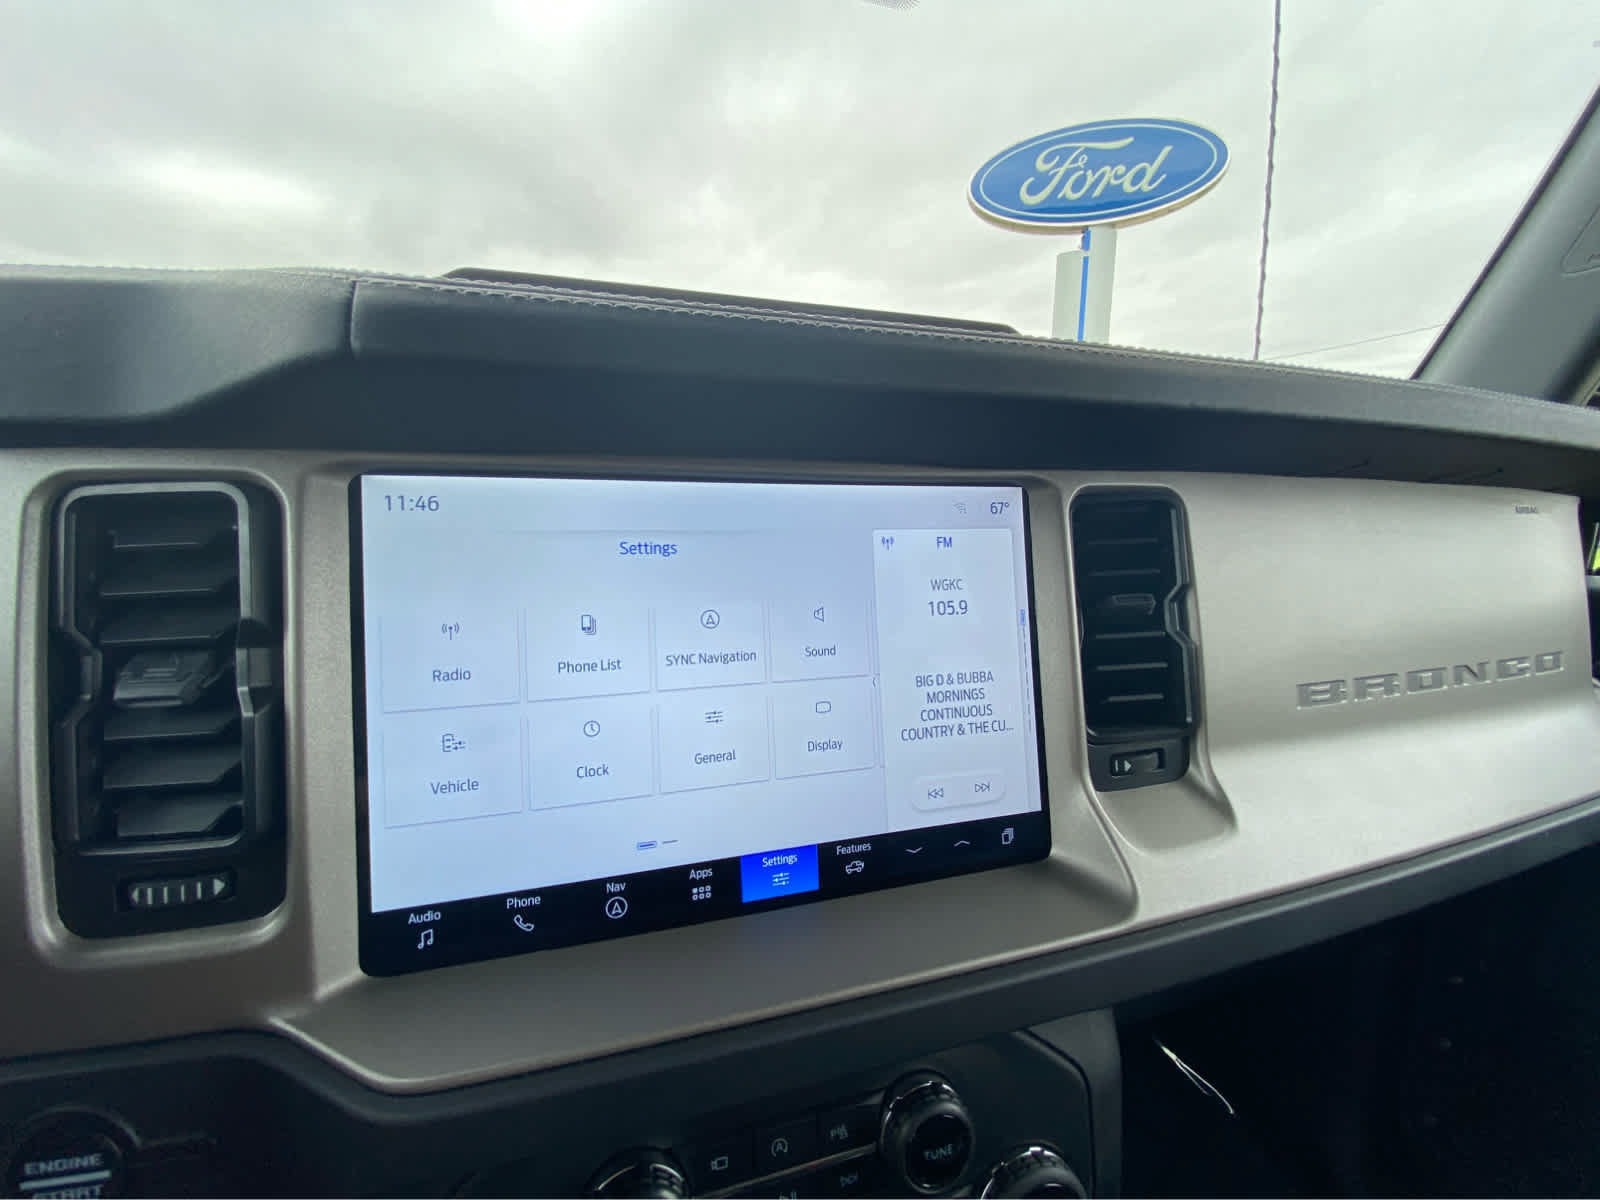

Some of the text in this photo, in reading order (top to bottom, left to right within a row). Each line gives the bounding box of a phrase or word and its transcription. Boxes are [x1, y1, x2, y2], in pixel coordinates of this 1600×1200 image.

[1019, 136, 1174, 205] Ford
[385, 495, 440, 512] 11:46
[619, 541, 678, 557] Settings
[936, 536, 952, 549] FM
[930, 578, 964, 592] WGKC
[928, 600, 968, 617] 105.9
[665, 650, 757, 667] SYNC Navigation
[805, 645, 836, 658] Sound
[557, 659, 622, 675] Phone List
[432, 669, 472, 683] Radio
[915, 670, 994, 688] BIG D & BUBBA
[1296, 650, 1565, 710] BRONCO
[926, 688, 985, 705] MORNINGS
[920, 703, 993, 722] CONTINUOUS
[901, 723, 955, 742] COUNTRY
[957, 723, 966, 737] &
[968, 721, 990, 736] THE
[807, 738, 843, 753] Display
[694, 749, 737, 765] General
[576, 763, 609, 779] Clock
[430, 777, 480, 796] Vehicle
[836, 841, 872, 856] Features
[762, 853, 798, 868] Settings
[689, 867, 713, 880] Apps
[605, 881, 626, 894] Nav
[506, 894, 542, 910] Phone
[408, 910, 441, 925] Audio
[923, 1143, 953, 1160] TUNE
[24, 1152, 104, 1176] ENGINE
